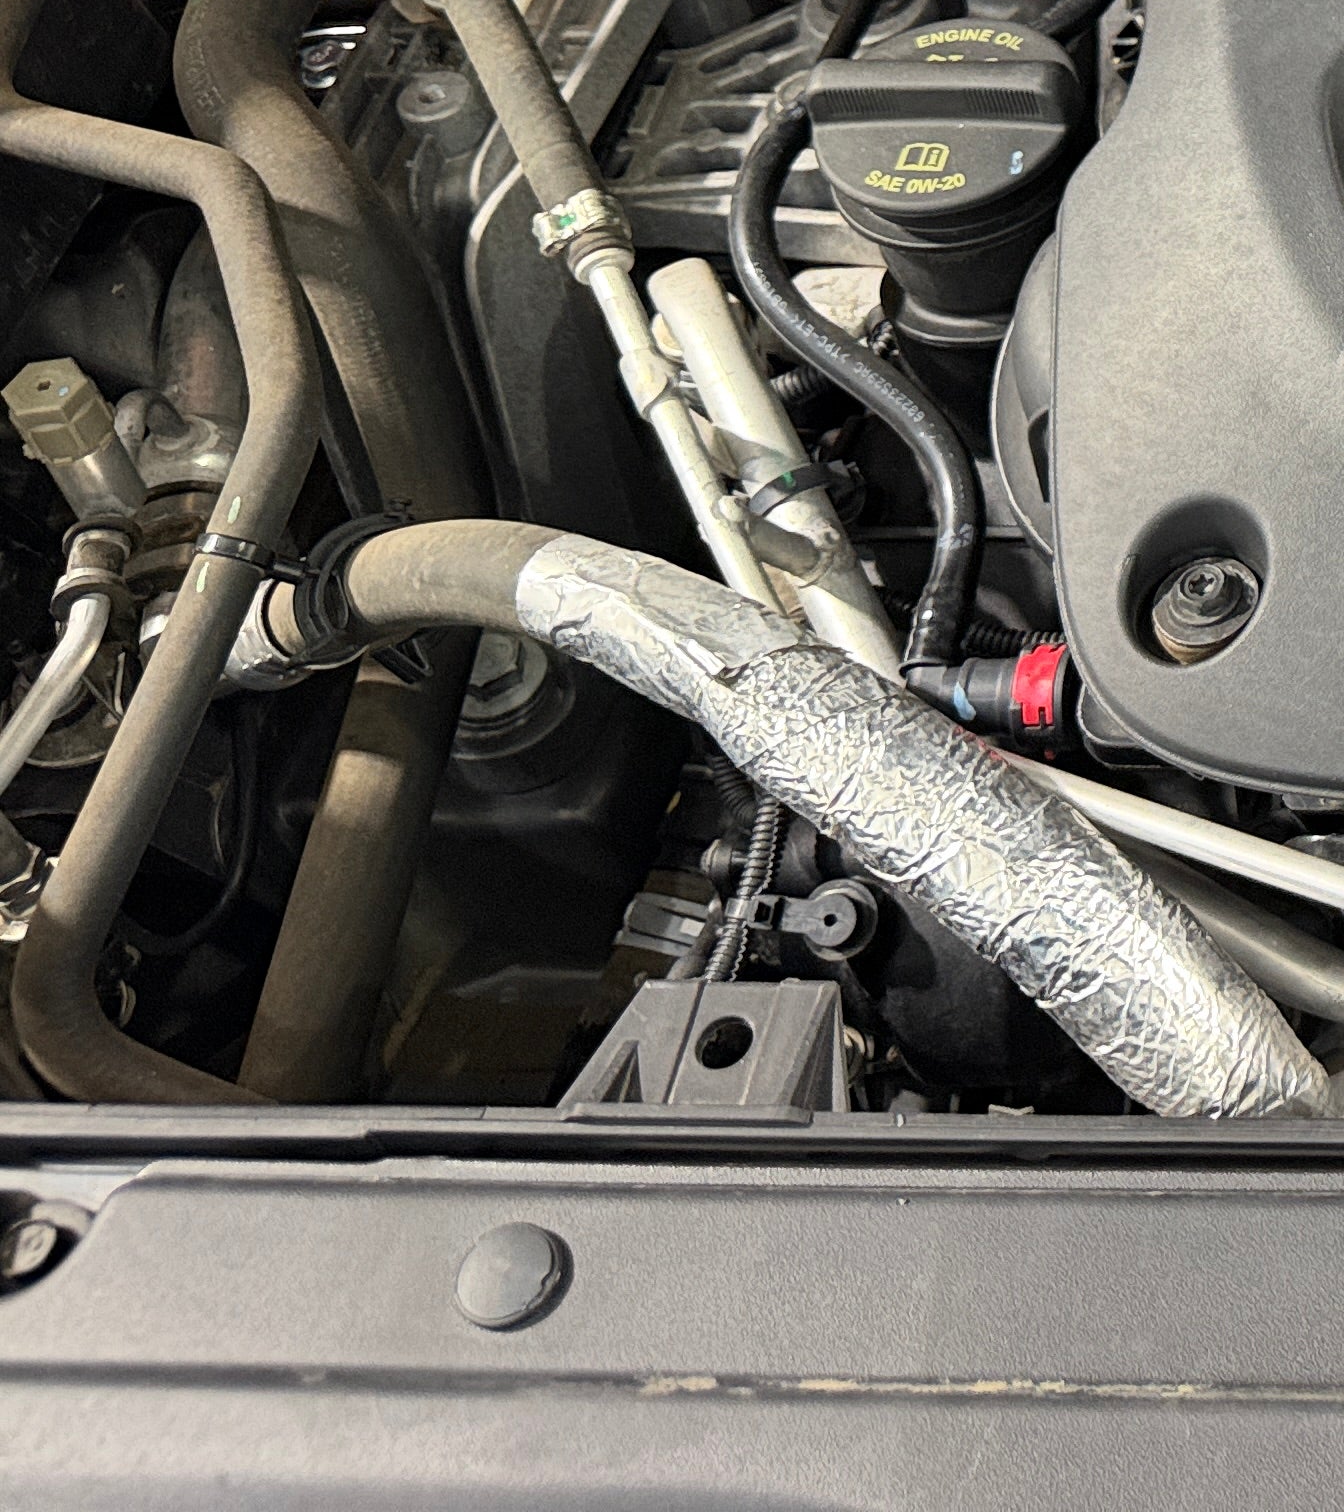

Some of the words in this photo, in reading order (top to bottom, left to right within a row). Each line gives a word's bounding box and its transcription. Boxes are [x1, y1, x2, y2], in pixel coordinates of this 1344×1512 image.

[916, 28, 995, 49] ENGINE
[994, 31, 1025, 51] OIL
[864, 170, 905, 193] SAE
[906, 173, 966, 194] 0W-20
